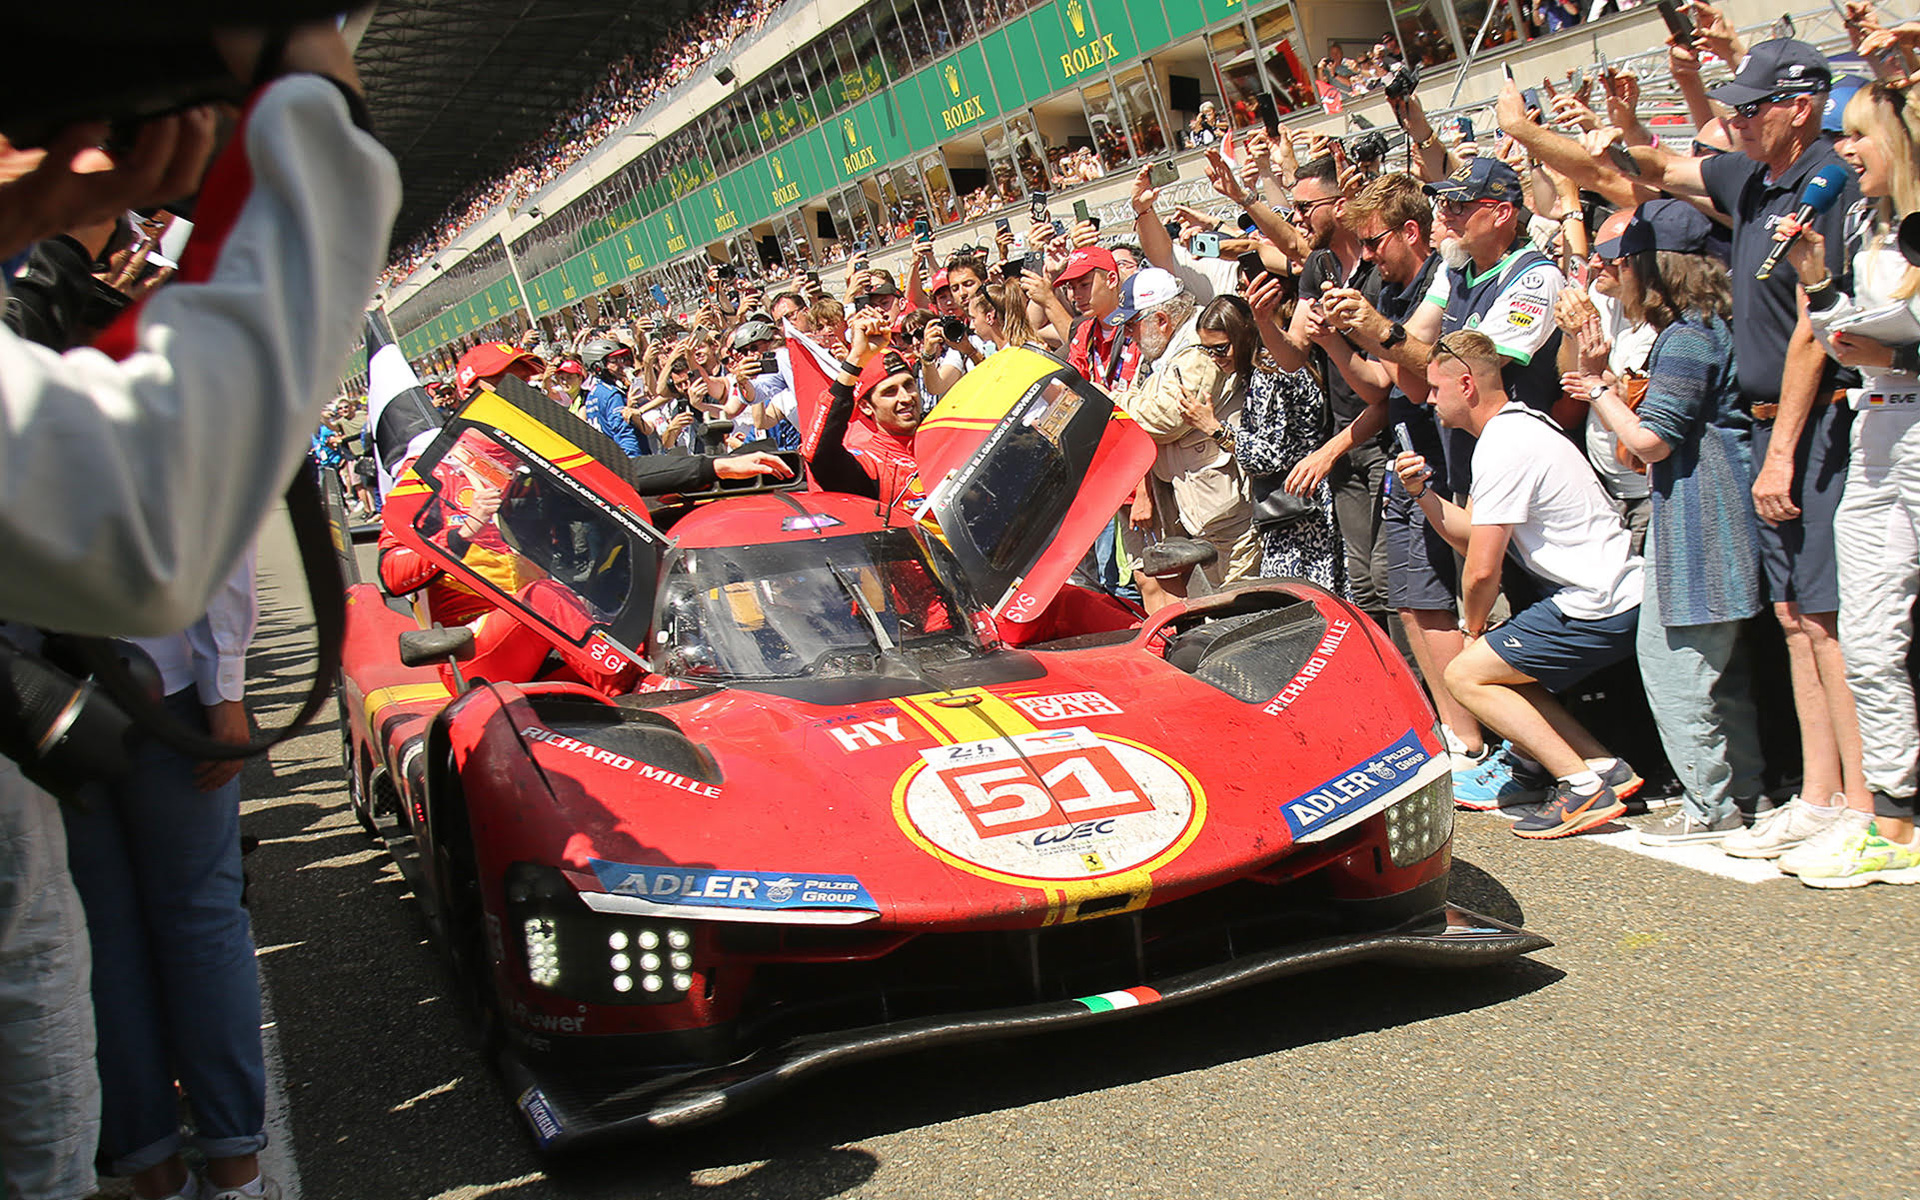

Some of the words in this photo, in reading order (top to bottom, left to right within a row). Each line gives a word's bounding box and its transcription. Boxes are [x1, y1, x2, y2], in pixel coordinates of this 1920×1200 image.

[1060, 33, 1120, 78] ROLEX
[941, 95, 986, 131] ROLEX
[842, 145, 877, 175] ROLEX
[771, 181, 801, 207] ROLEX
[714, 210, 739, 233] ROLEX
[1005, 593, 1037, 622] SYS
[1263, 656, 1328, 716] RICHARD
[1317, 619, 1352, 657] MILLE
[1021, 693, 1101, 707] HYPER
[1033, 701, 1115, 718] CAR
[829, 716, 906, 752] HY
[520, 726, 635, 771] RICHARD
[638, 763, 723, 799] MILLE
[1382, 745, 1415, 764] PELZER
[1394, 752, 1426, 771] GROUP
[952, 756, 1141, 829] 51
[1288, 771, 1380, 828] ADLER
[1033, 819, 1116, 847] WEC
[611, 873, 760, 900] ADLER
[802, 891, 857, 903] GROUP
[804, 880, 859, 892] PELZER
[527, 1099, 559, 1140] MICHELIN
